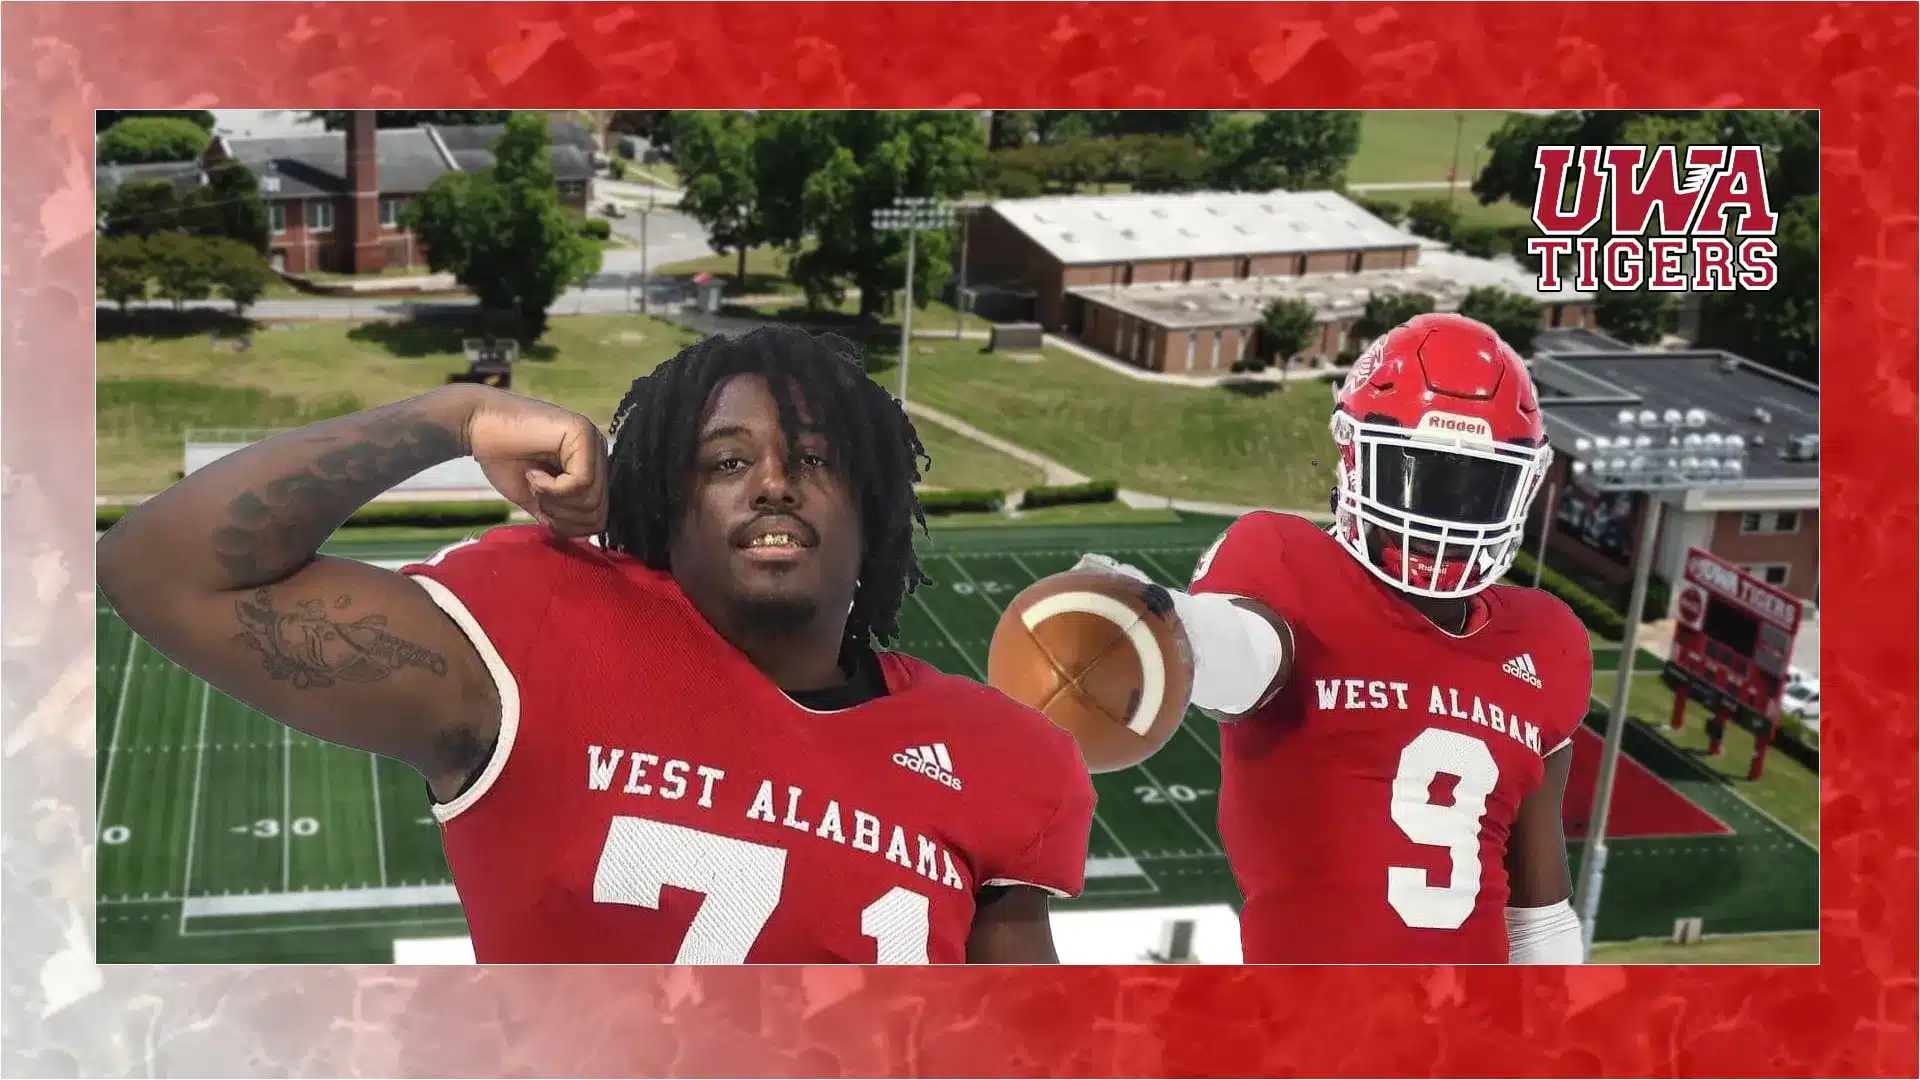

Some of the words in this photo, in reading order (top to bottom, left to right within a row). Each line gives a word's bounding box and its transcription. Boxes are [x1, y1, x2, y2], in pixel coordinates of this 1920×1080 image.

[1429, 416, 1485, 435] Riddell
[1502, 663, 1543, 689] adidas
[1315, 679, 1409, 710] WEST
[1428, 685, 1542, 757] ALABAM
[892, 752, 963, 792] adidas
[253, 817, 321, 839] 30
[588, 745, 725, 809] WEST
[746, 780, 964, 890] ALABAMA
[1388, 727, 1500, 929] 9
[593, 815, 930, 964] 71
